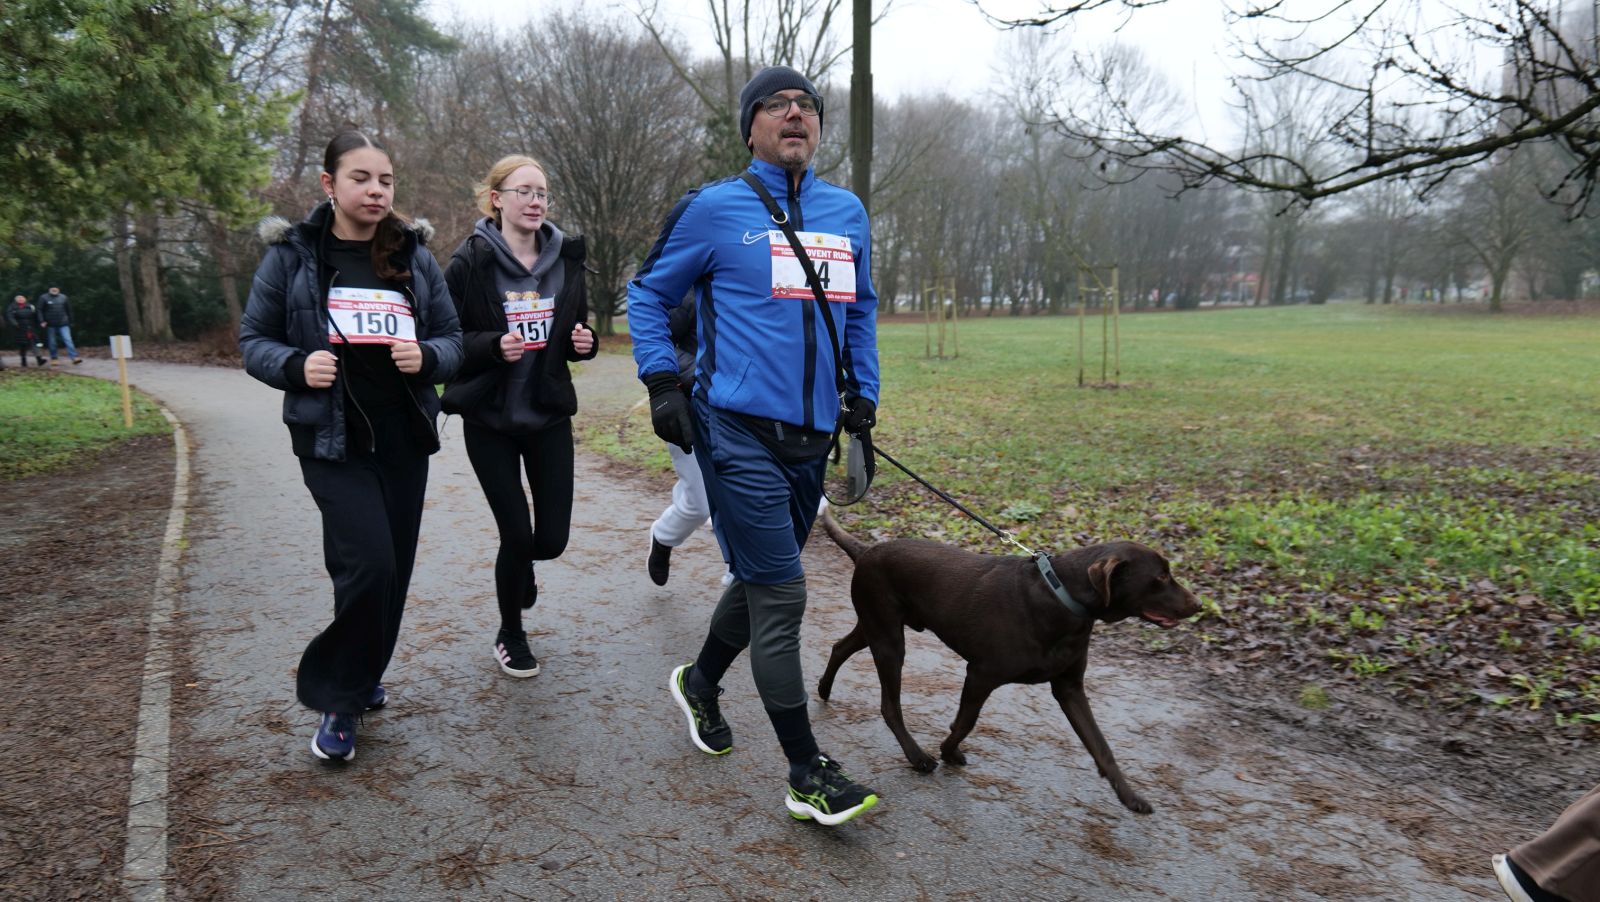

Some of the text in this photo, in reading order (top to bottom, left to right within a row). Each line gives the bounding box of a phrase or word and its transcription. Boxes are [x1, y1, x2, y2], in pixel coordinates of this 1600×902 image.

[806, 248, 832, 259] DVENT
[352, 312, 398, 336] 150
[516, 320, 548, 342] 151
